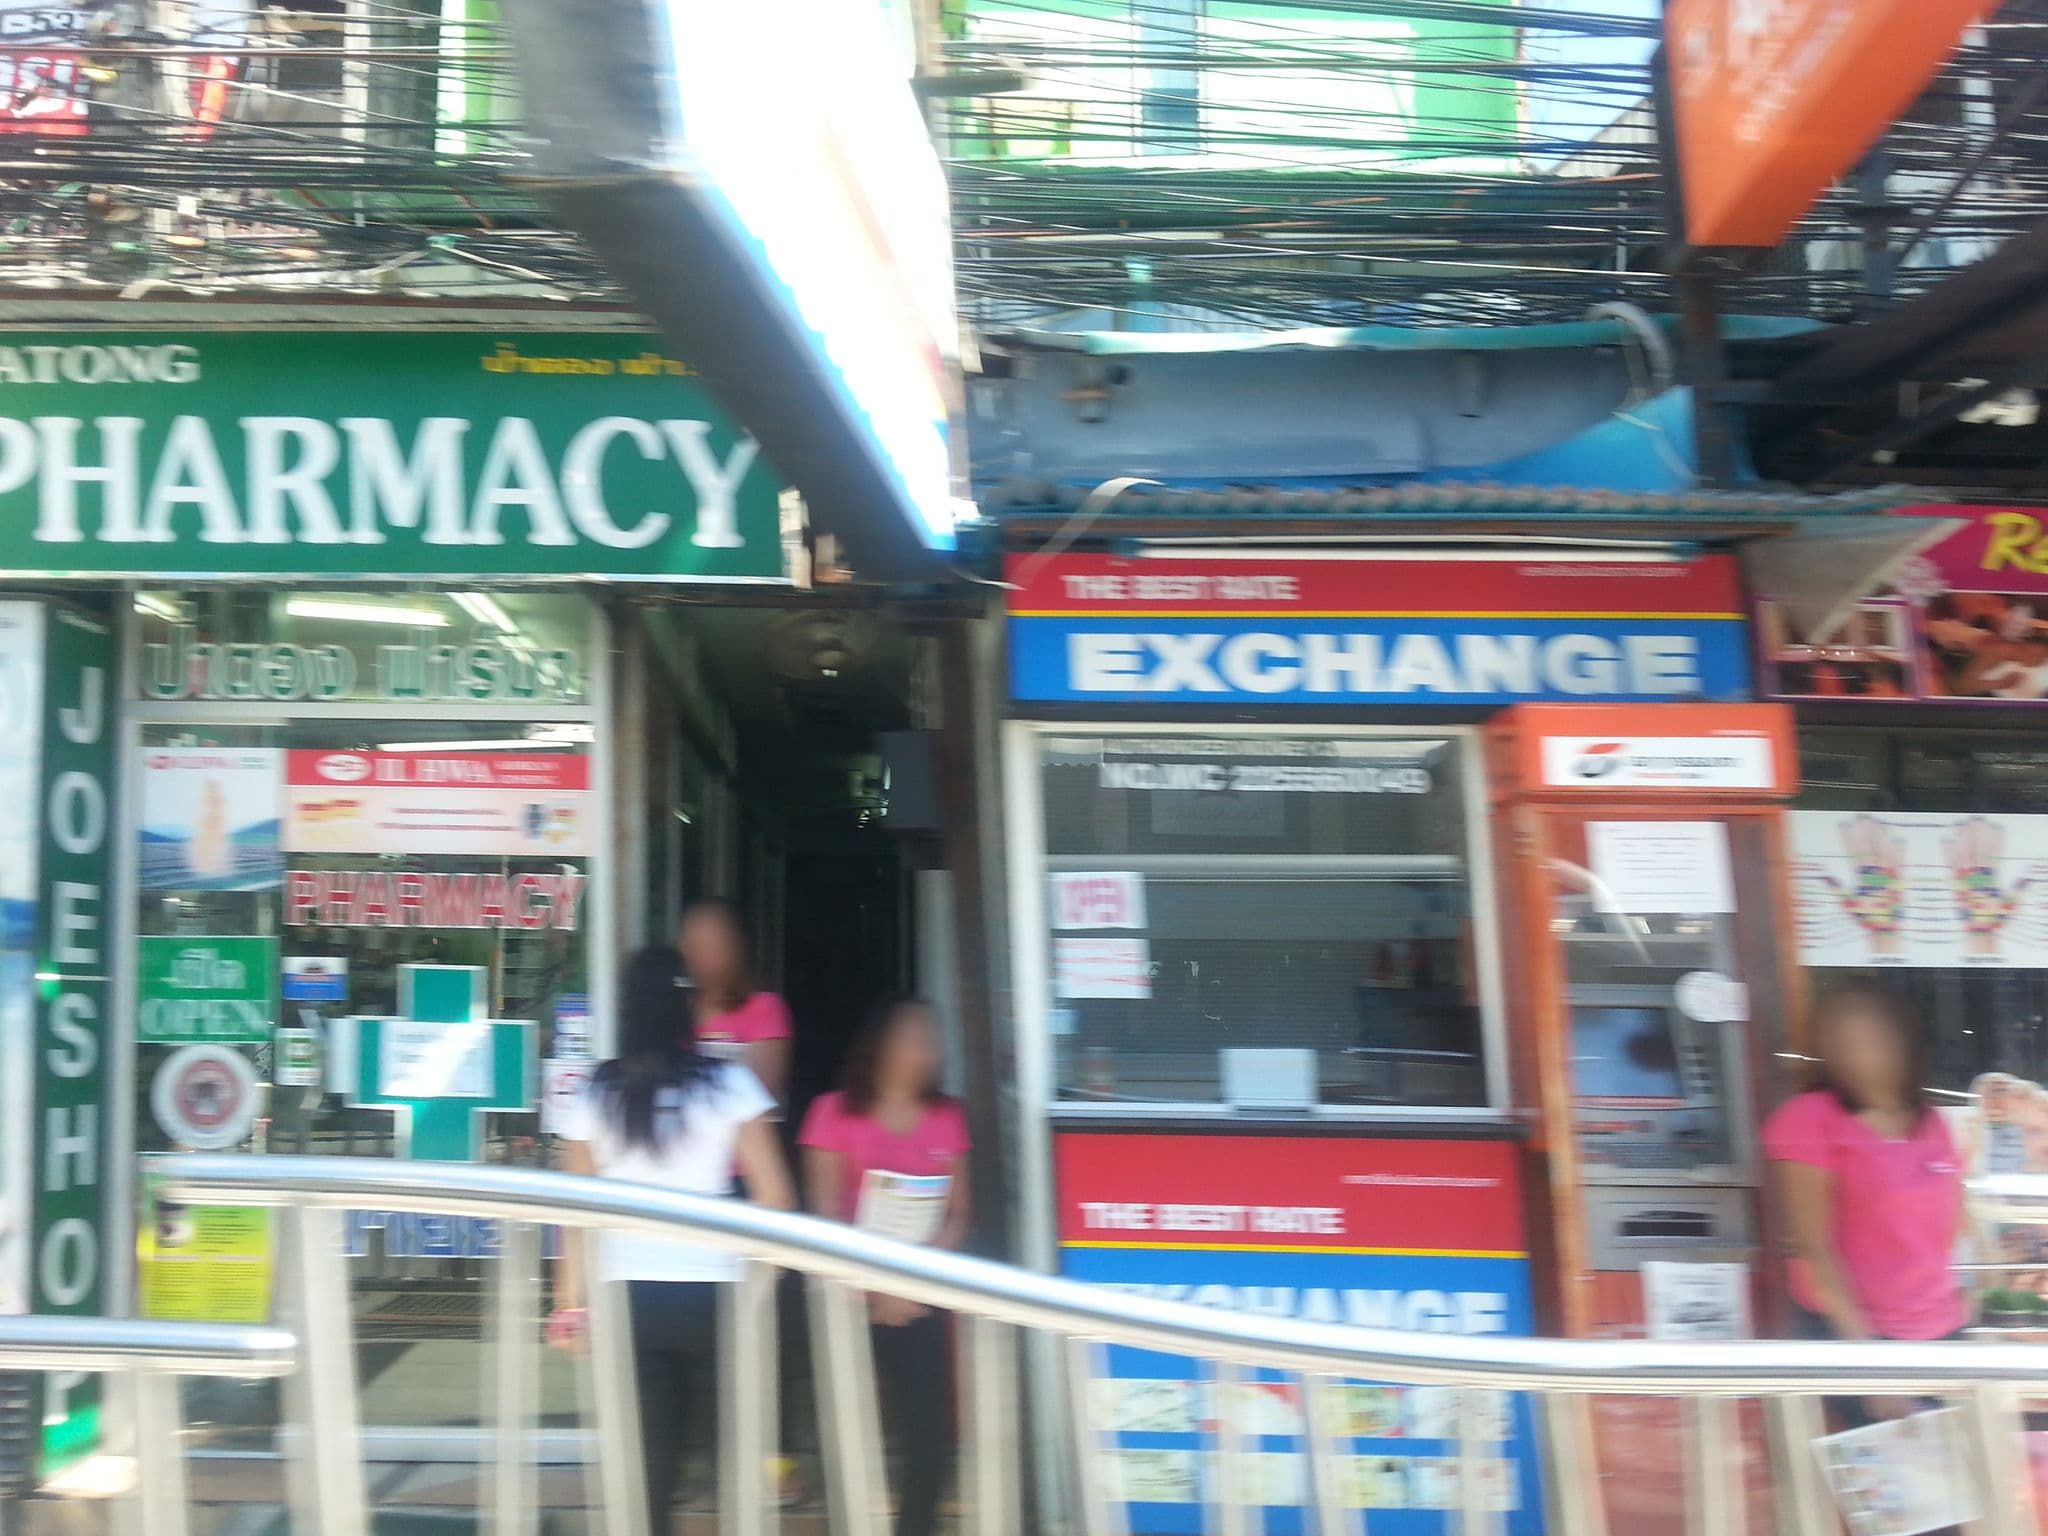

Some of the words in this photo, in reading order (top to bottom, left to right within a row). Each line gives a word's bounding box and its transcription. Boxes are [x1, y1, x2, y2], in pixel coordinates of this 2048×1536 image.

[1060, 575, 1129, 601] THE
[1132, 575, 1212, 601] BEST
[1214, 576, 1301, 601] RATE
[1065, 632, 1700, 695] EXCHANGE
[284, 870, 584, 930] PHARMACY
[140, 998, 272, 1036] OPEN
[1078, 1202, 1153, 1230] THE
[1156, 1204, 1247, 1232] BEST
[1250, 1206, 1347, 1235] RATE
